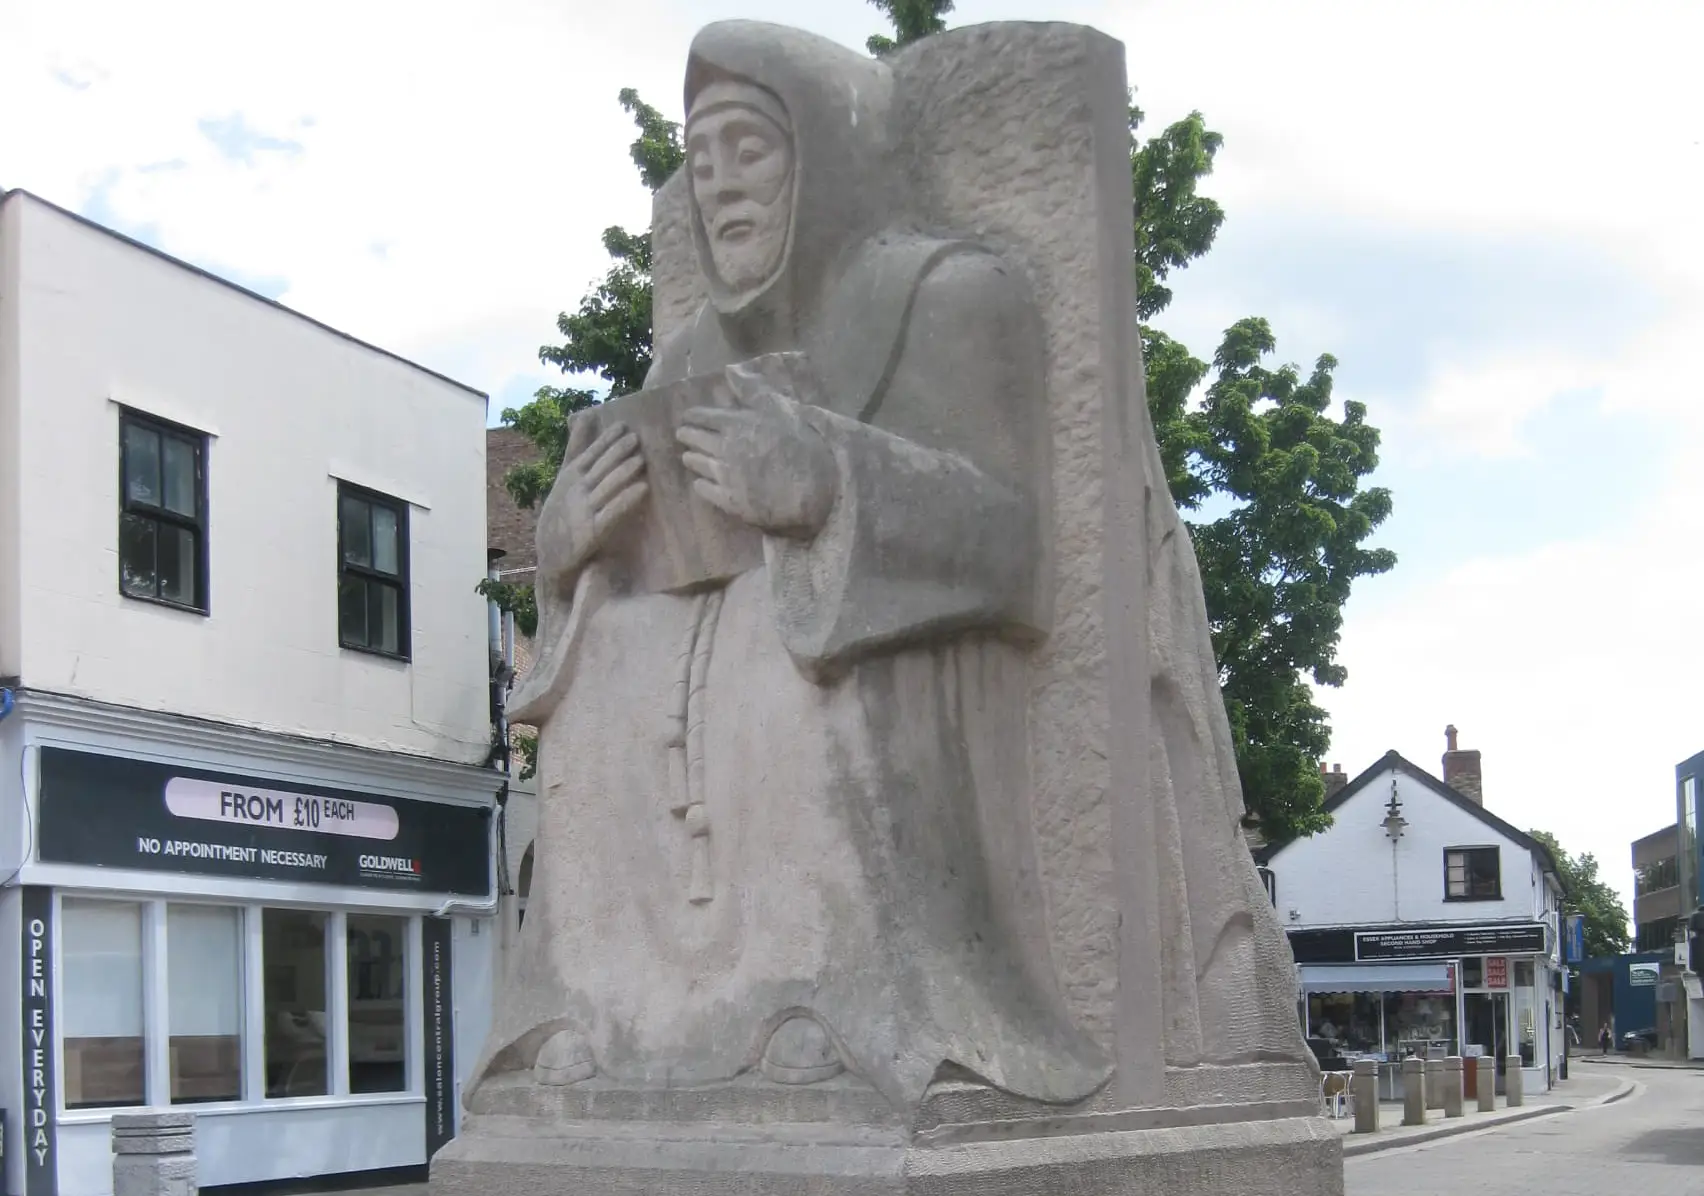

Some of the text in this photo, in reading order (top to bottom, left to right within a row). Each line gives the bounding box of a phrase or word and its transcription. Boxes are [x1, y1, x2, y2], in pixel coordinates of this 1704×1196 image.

[220, 790, 355, 828] FROM £10 EACH
[138, 837, 328, 870] NO APPOINTMENT NECESSARY
[359, 854, 415, 872] GOLDWELL
[30, 919, 45, 997] OPEN
